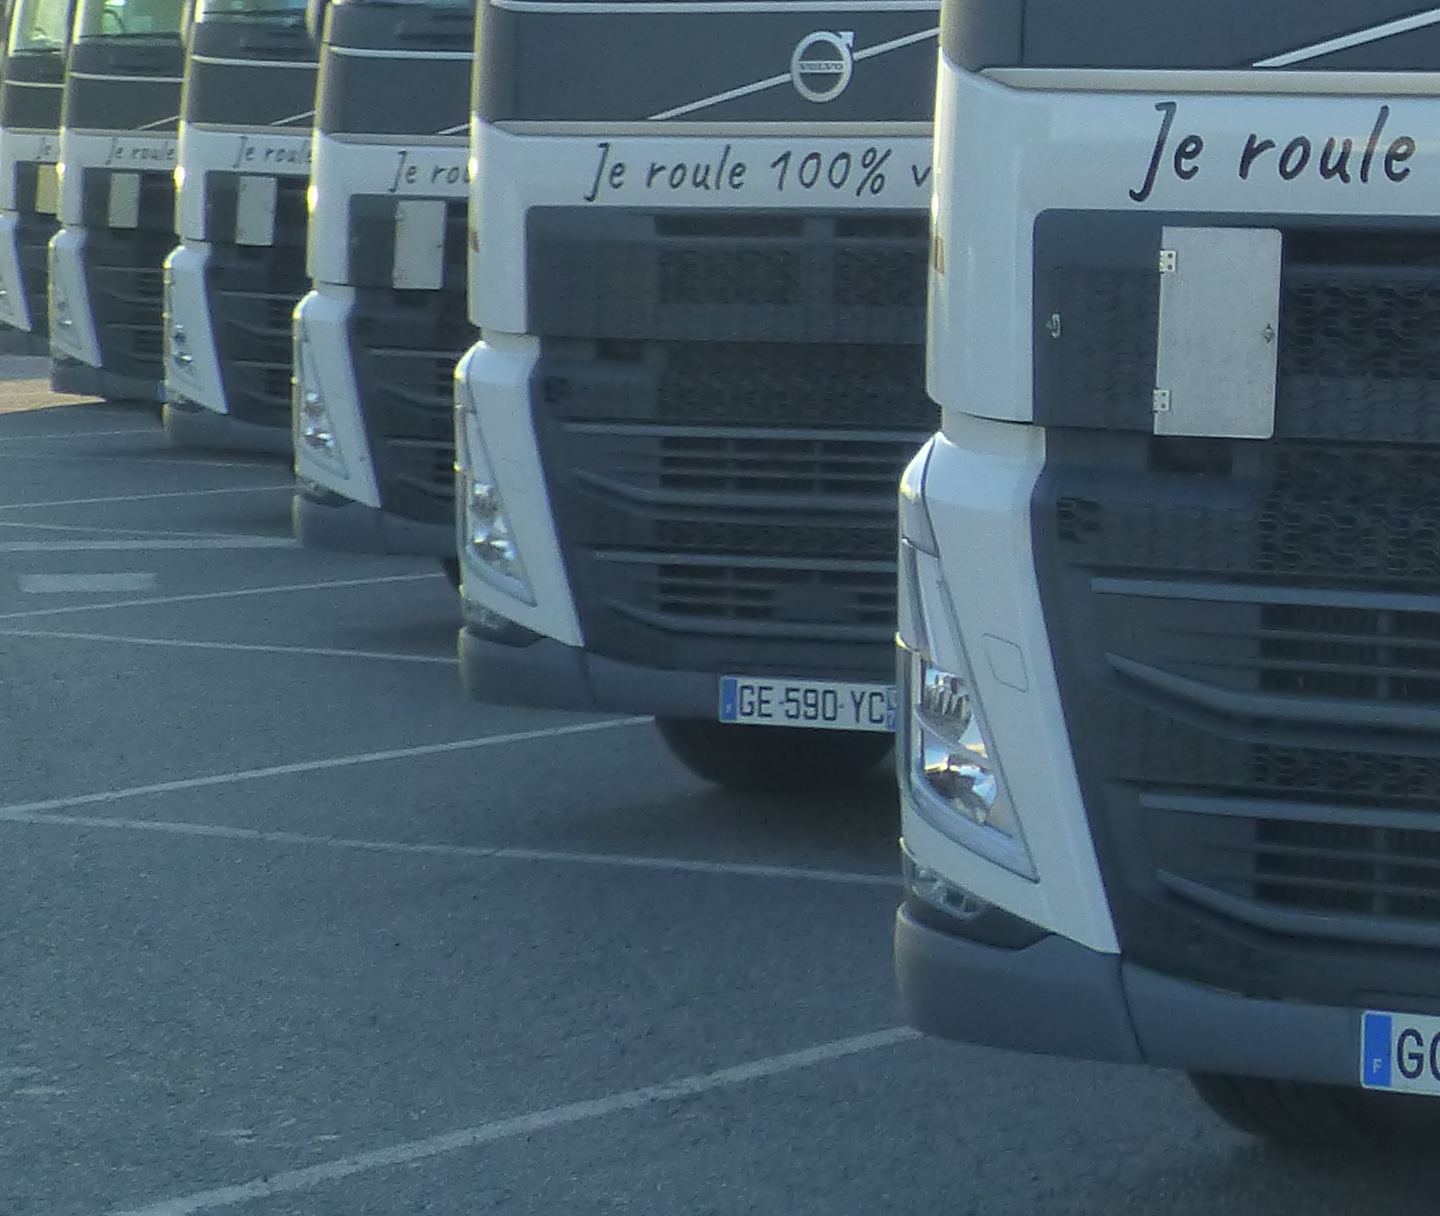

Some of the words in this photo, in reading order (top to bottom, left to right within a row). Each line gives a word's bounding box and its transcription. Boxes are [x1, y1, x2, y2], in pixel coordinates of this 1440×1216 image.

[799, 61, 845, 71] VOLVO
[232, 135, 255, 169] Je
[389, 150, 417, 193] Je
[584, 142, 627, 202] Je
[646, 144, 746, 191] roule
[770, 146, 892, 196] 100%
[1129, 101, 1204, 202] Je
[1238, 105, 1416, 182] roule
